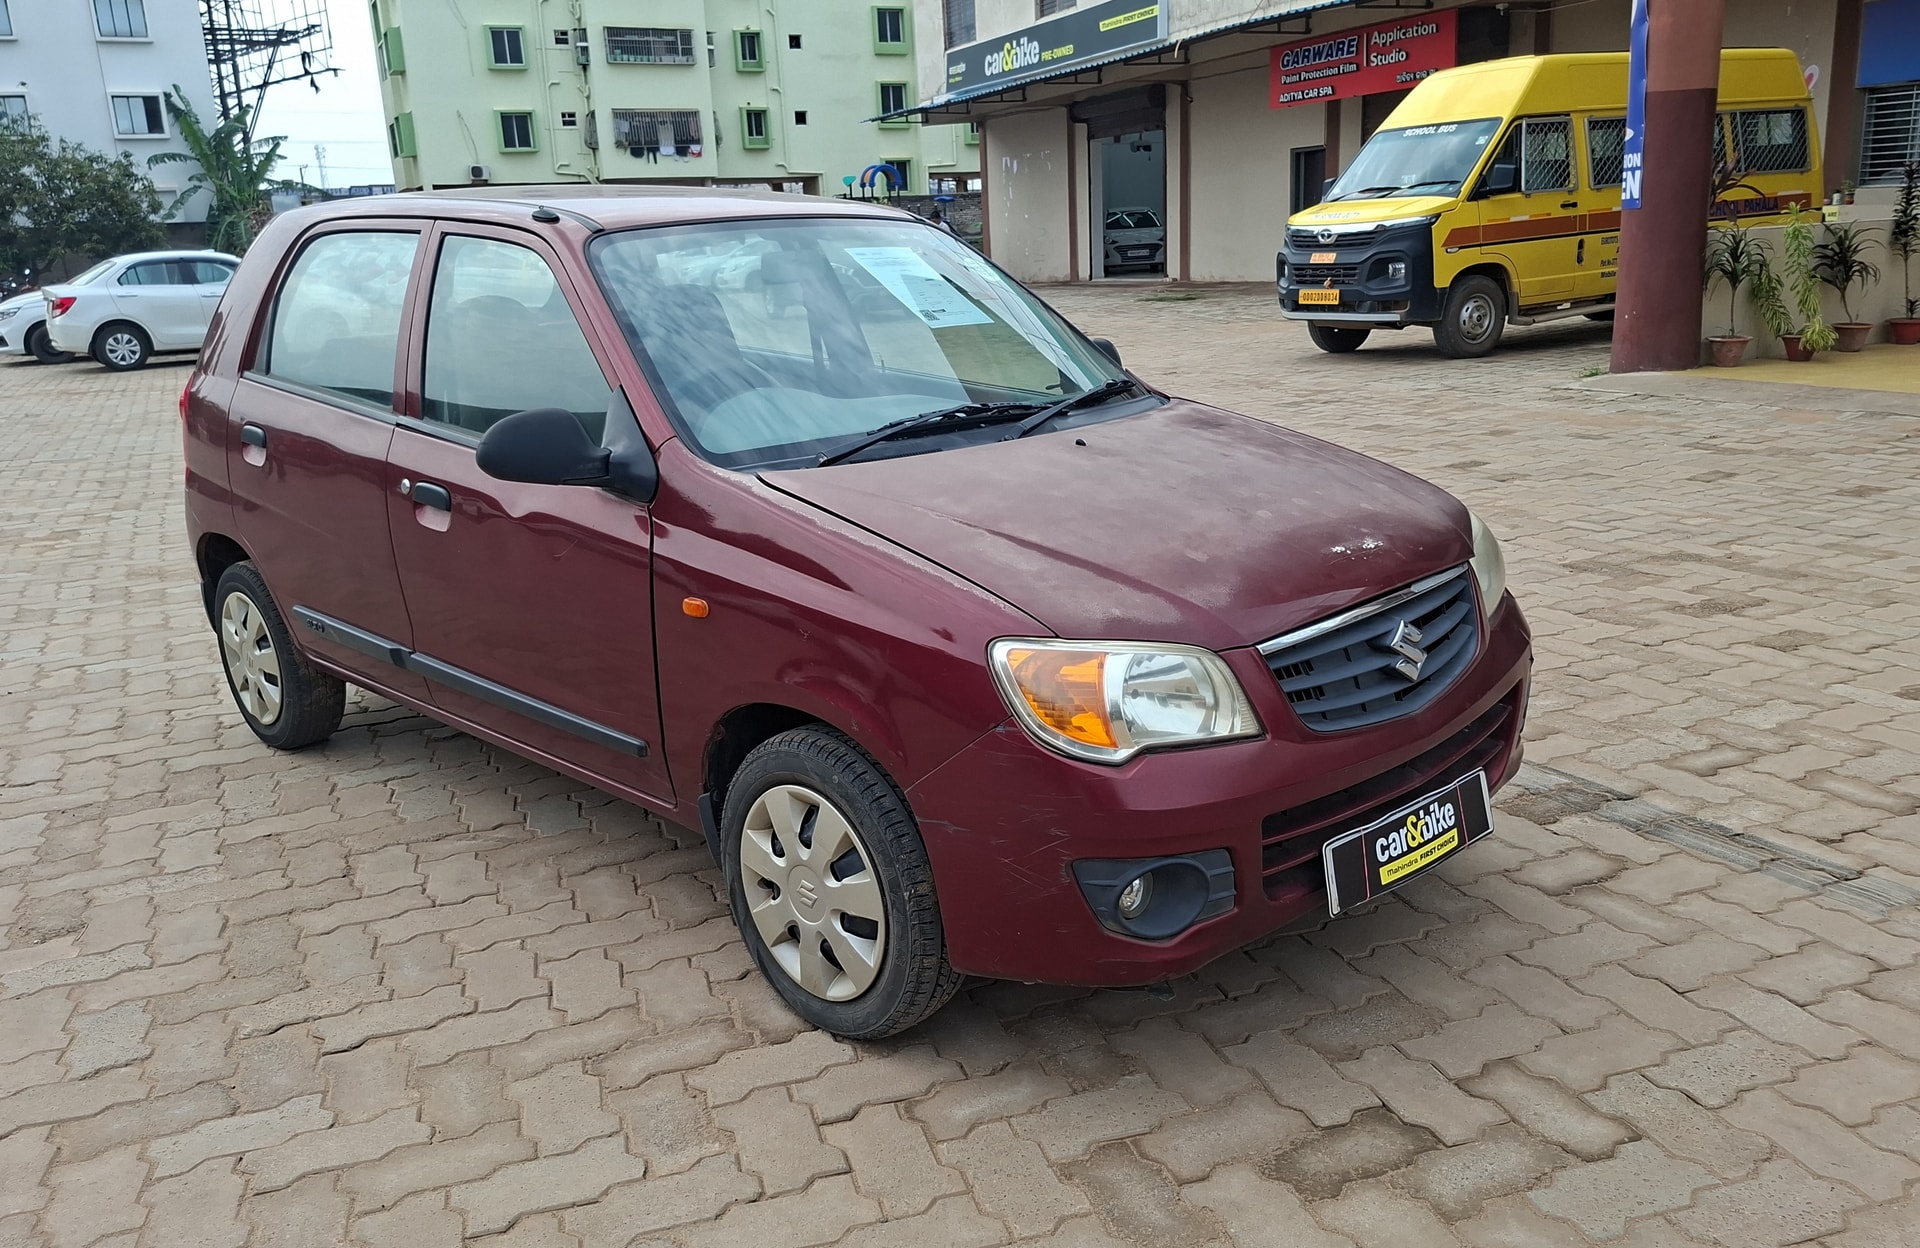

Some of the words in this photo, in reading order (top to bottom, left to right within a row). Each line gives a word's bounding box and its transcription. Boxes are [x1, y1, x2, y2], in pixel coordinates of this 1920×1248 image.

[1123, 13, 1137, 23] FIRST
[1137, 8, 1156, 19] CHOICE
[1371, 22, 1437, 46] Application
[984, 36, 1040, 76] car&bike
[1041, 44, 1074, 62] PRE-OWNED
[1280, 36, 1359, 70] GARWARE
[1370, 50, 1407, 67] Studio
[1281, 71, 1300, 84] Paint
[1301, 67, 1339, 81] Protection
[1339, 63, 1357, 74] Film
[1279, 89, 1303, 102] ADITYA
[1304, 88, 1319, 99] CAR
[1319, 86, 1333, 97] SPA
[1403, 126, 1436, 137] SCHOOL
[1437, 124, 1458, 134] BUS
[1375, 801, 1456, 863] car&bike
[1387, 857, 1419, 877] Mahindra
[1419, 846, 1437, 861] FIRST
[1437, 834, 1456, 851] CHOICE
